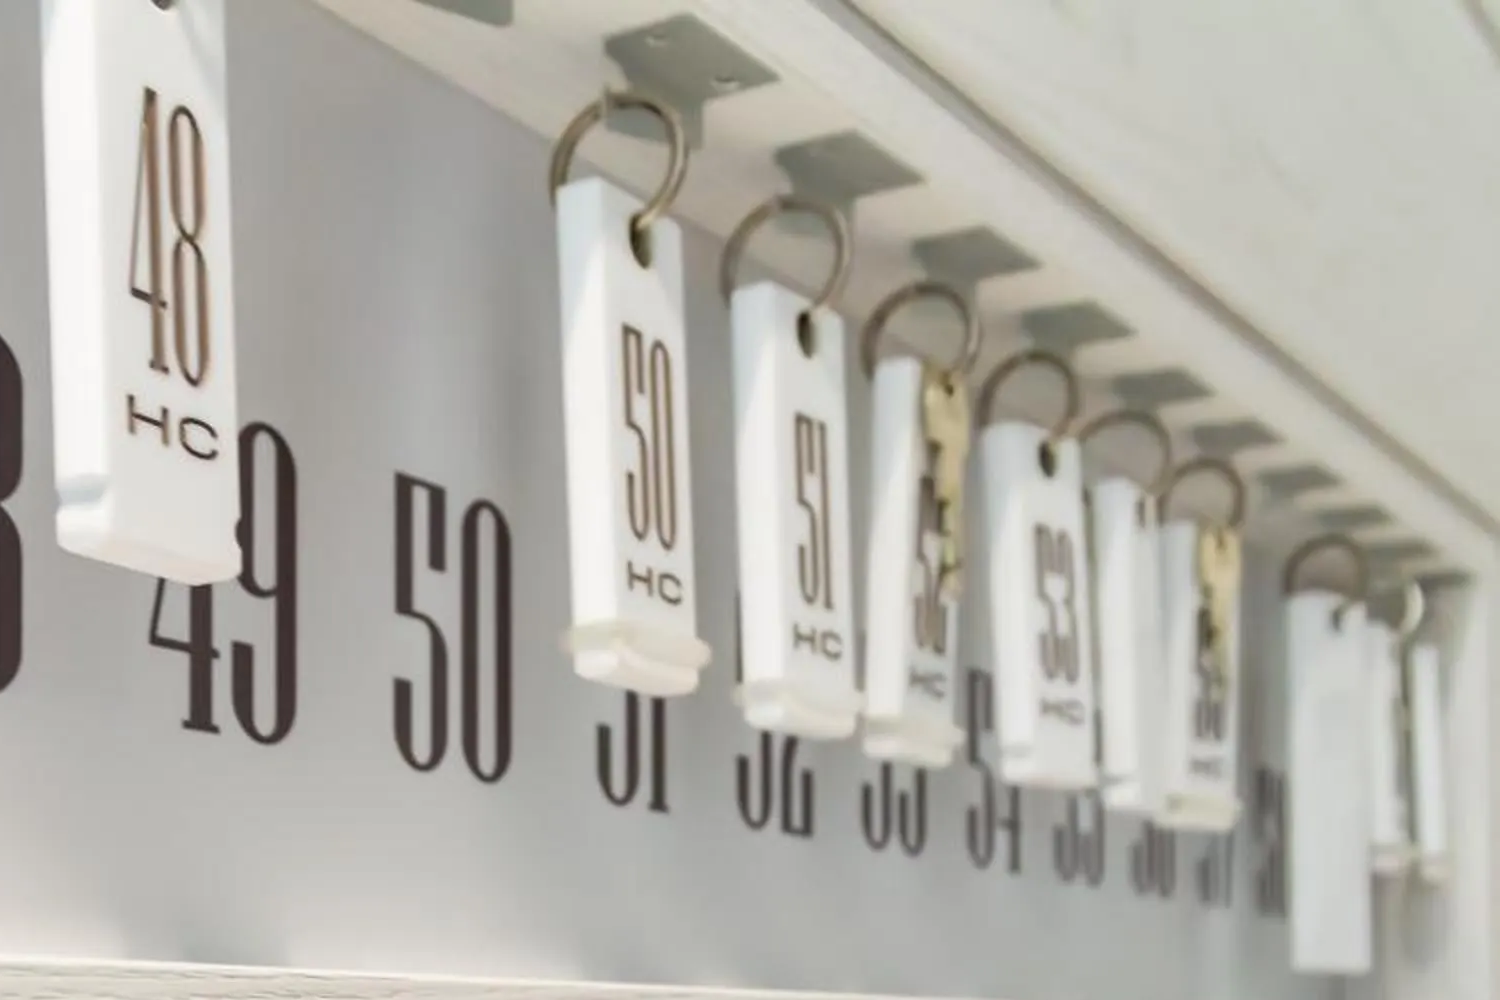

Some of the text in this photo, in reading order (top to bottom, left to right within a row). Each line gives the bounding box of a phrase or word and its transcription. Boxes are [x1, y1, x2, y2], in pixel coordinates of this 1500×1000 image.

[129, 86, 210, 388] 48
[126, 394, 219, 461] HC
[621, 322, 677, 551] 50
[793, 411, 835, 611] 51
[393, 470, 513, 784] 50
[626, 560, 683, 606] HC
[792, 623, 843, 662] HC
